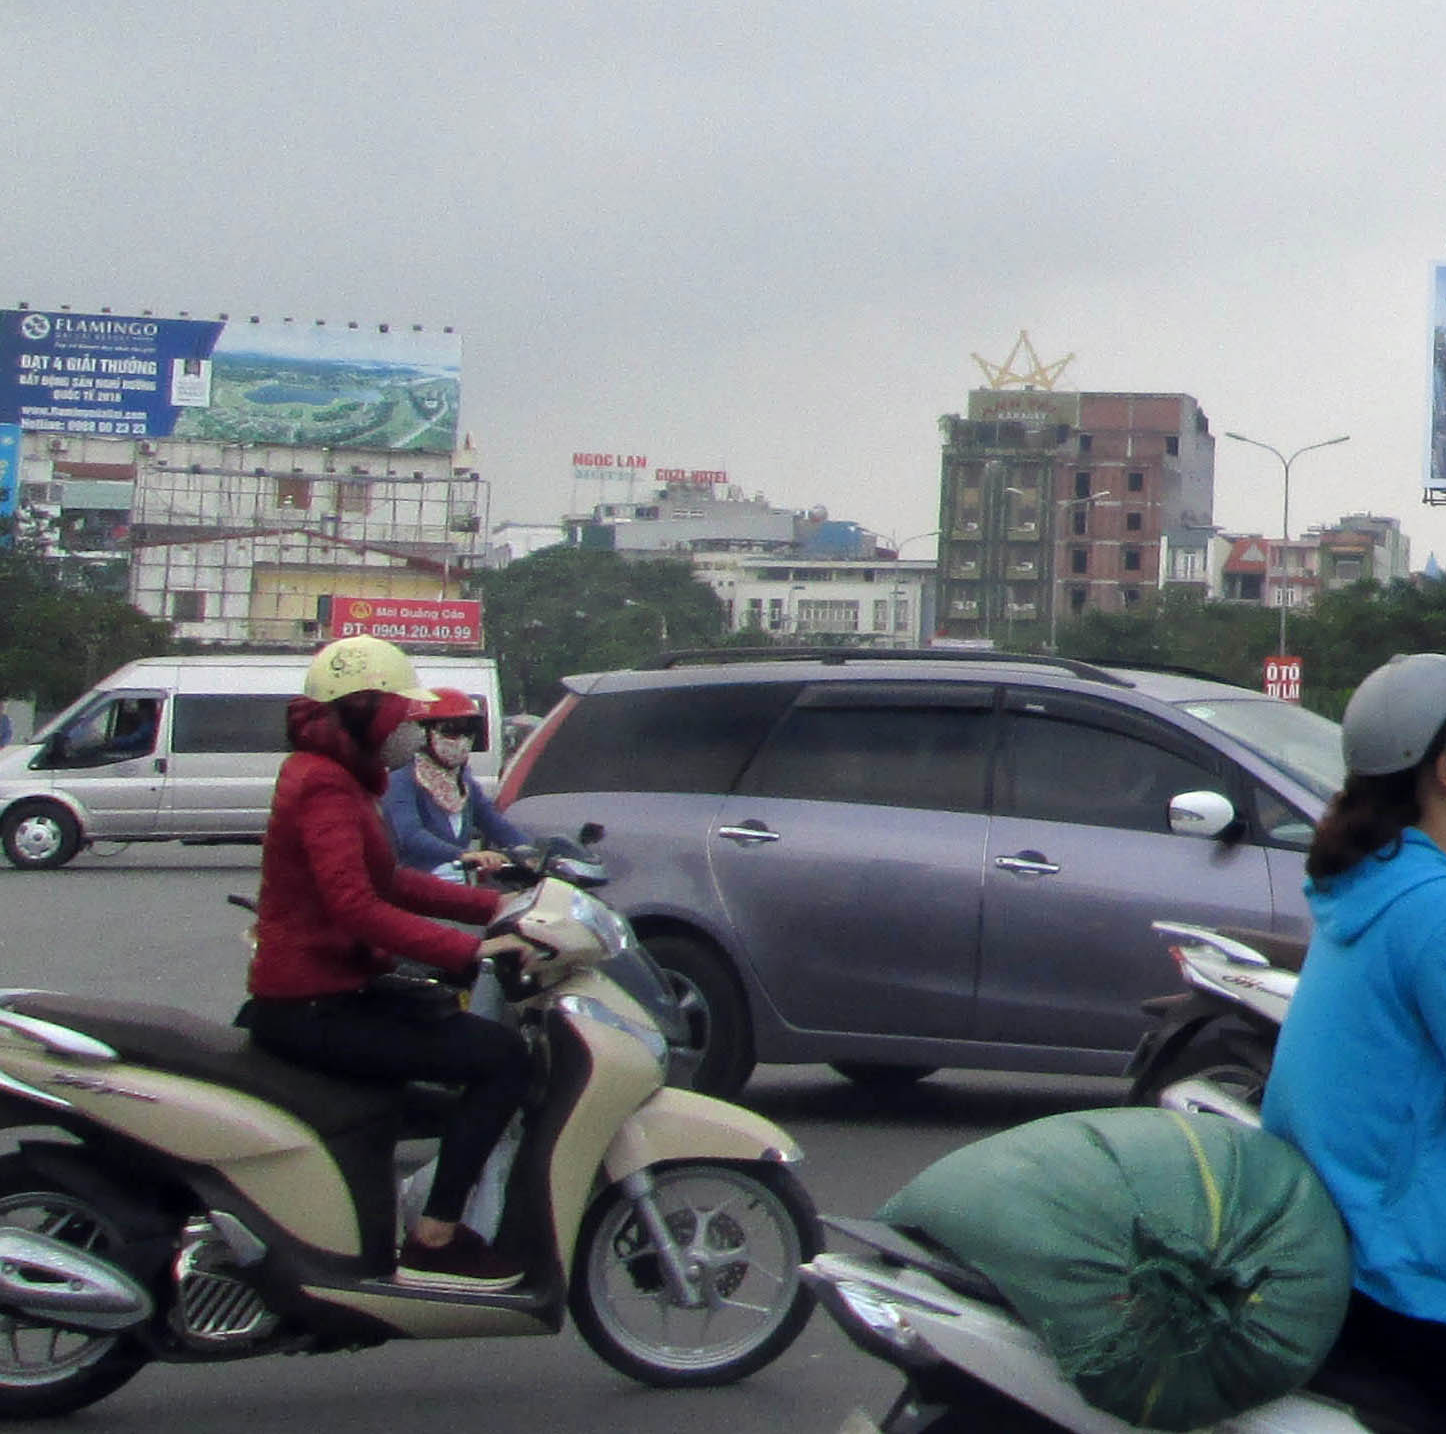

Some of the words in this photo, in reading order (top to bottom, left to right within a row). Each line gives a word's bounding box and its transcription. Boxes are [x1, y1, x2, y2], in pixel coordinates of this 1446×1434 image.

[55, 318, 158, 336] FLAMINGO
[53, 357, 62, 370] 4
[617, 454, 646, 468] LAN
[372, 624, 472, 639] 0904.20.40.99
[1267, 662, 1278, 681] Ô
[1280, 662, 1300, 681] TÔ
